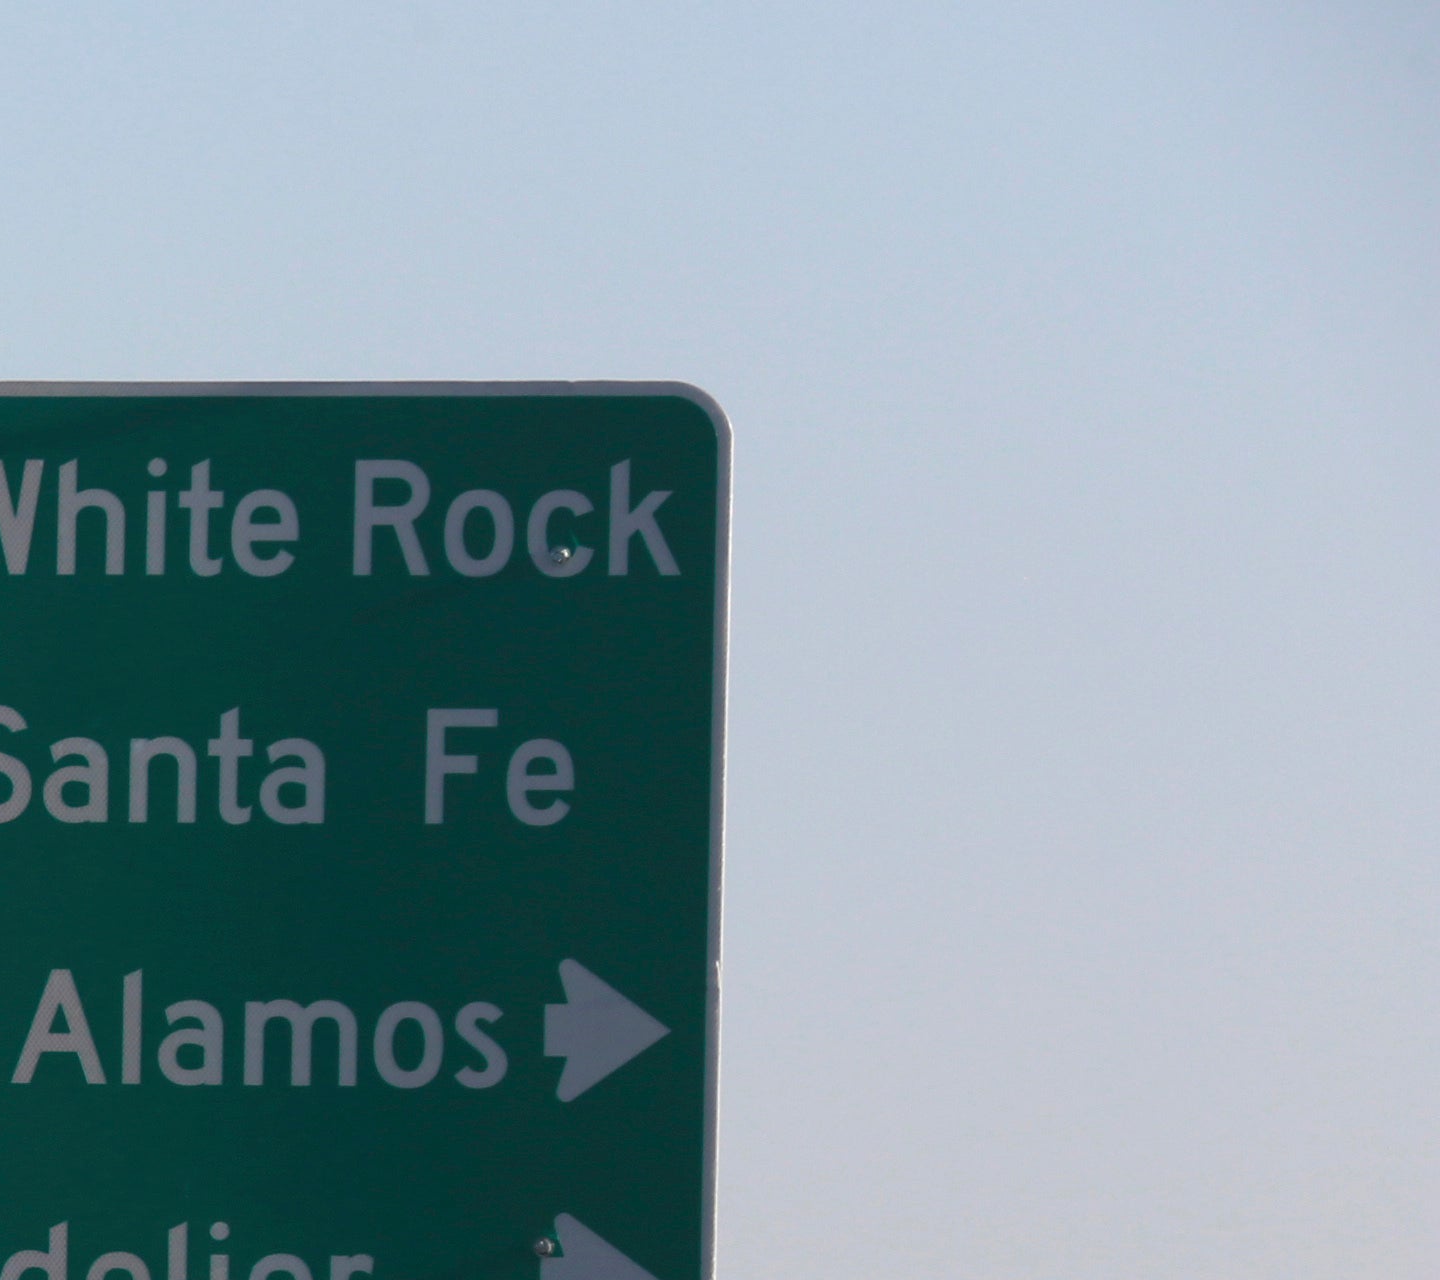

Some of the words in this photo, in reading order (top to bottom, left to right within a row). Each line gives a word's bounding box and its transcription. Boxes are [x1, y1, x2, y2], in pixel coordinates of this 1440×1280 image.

[351, 459, 681, 578] Rock
[424, 708, 576, 827] Fe
[11, 968, 508, 1090] Alamos
